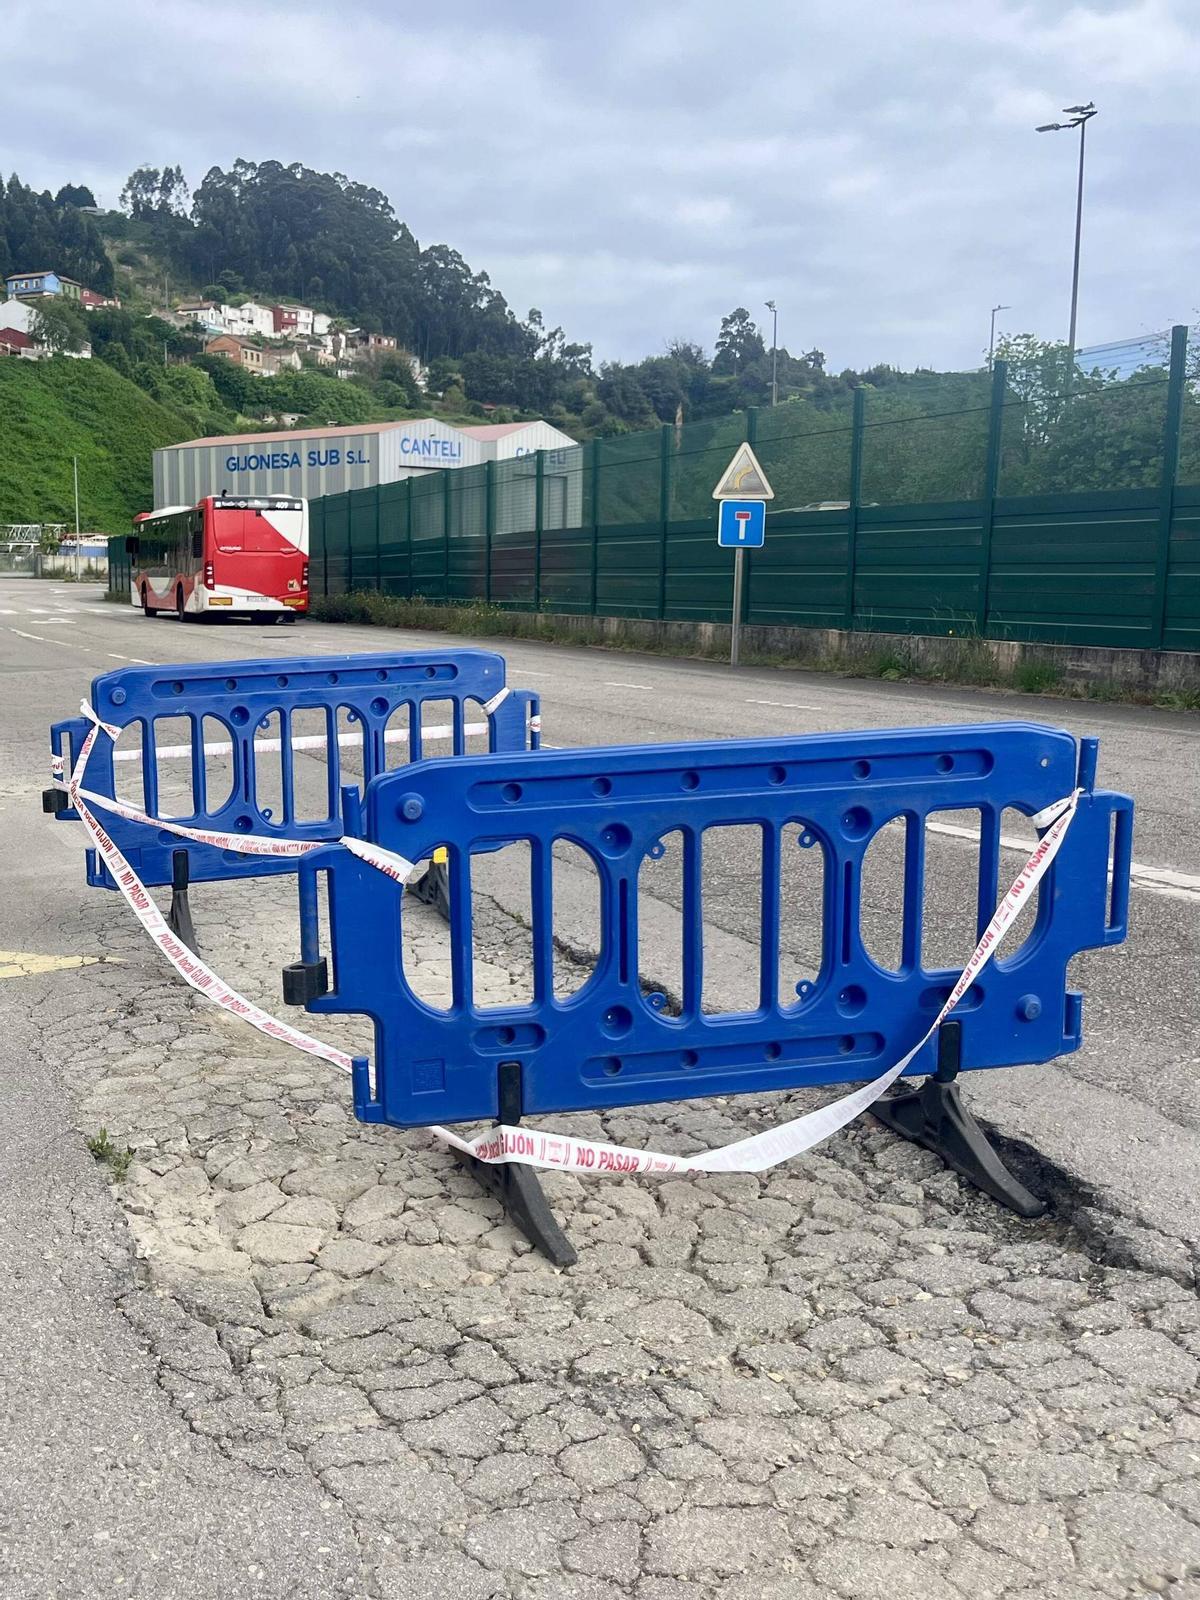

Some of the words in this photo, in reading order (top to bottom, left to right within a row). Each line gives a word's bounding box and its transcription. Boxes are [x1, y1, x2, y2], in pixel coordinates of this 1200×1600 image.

[400, 438, 461, 458] CANTELI
[226, 453, 301, 472] GIJONESA
[307, 449, 340, 467] SUB
[346, 450, 370, 464] S.L.
[275, 501, 289, 509] 409
[120, 871, 135, 886] NO
[127, 884, 150, 910] PASAR
[178, 955, 197, 976] local
[955, 967, 973, 997] local
[576, 1147, 595, 1167] NO
[598, 1152, 639, 1172] PASAR
